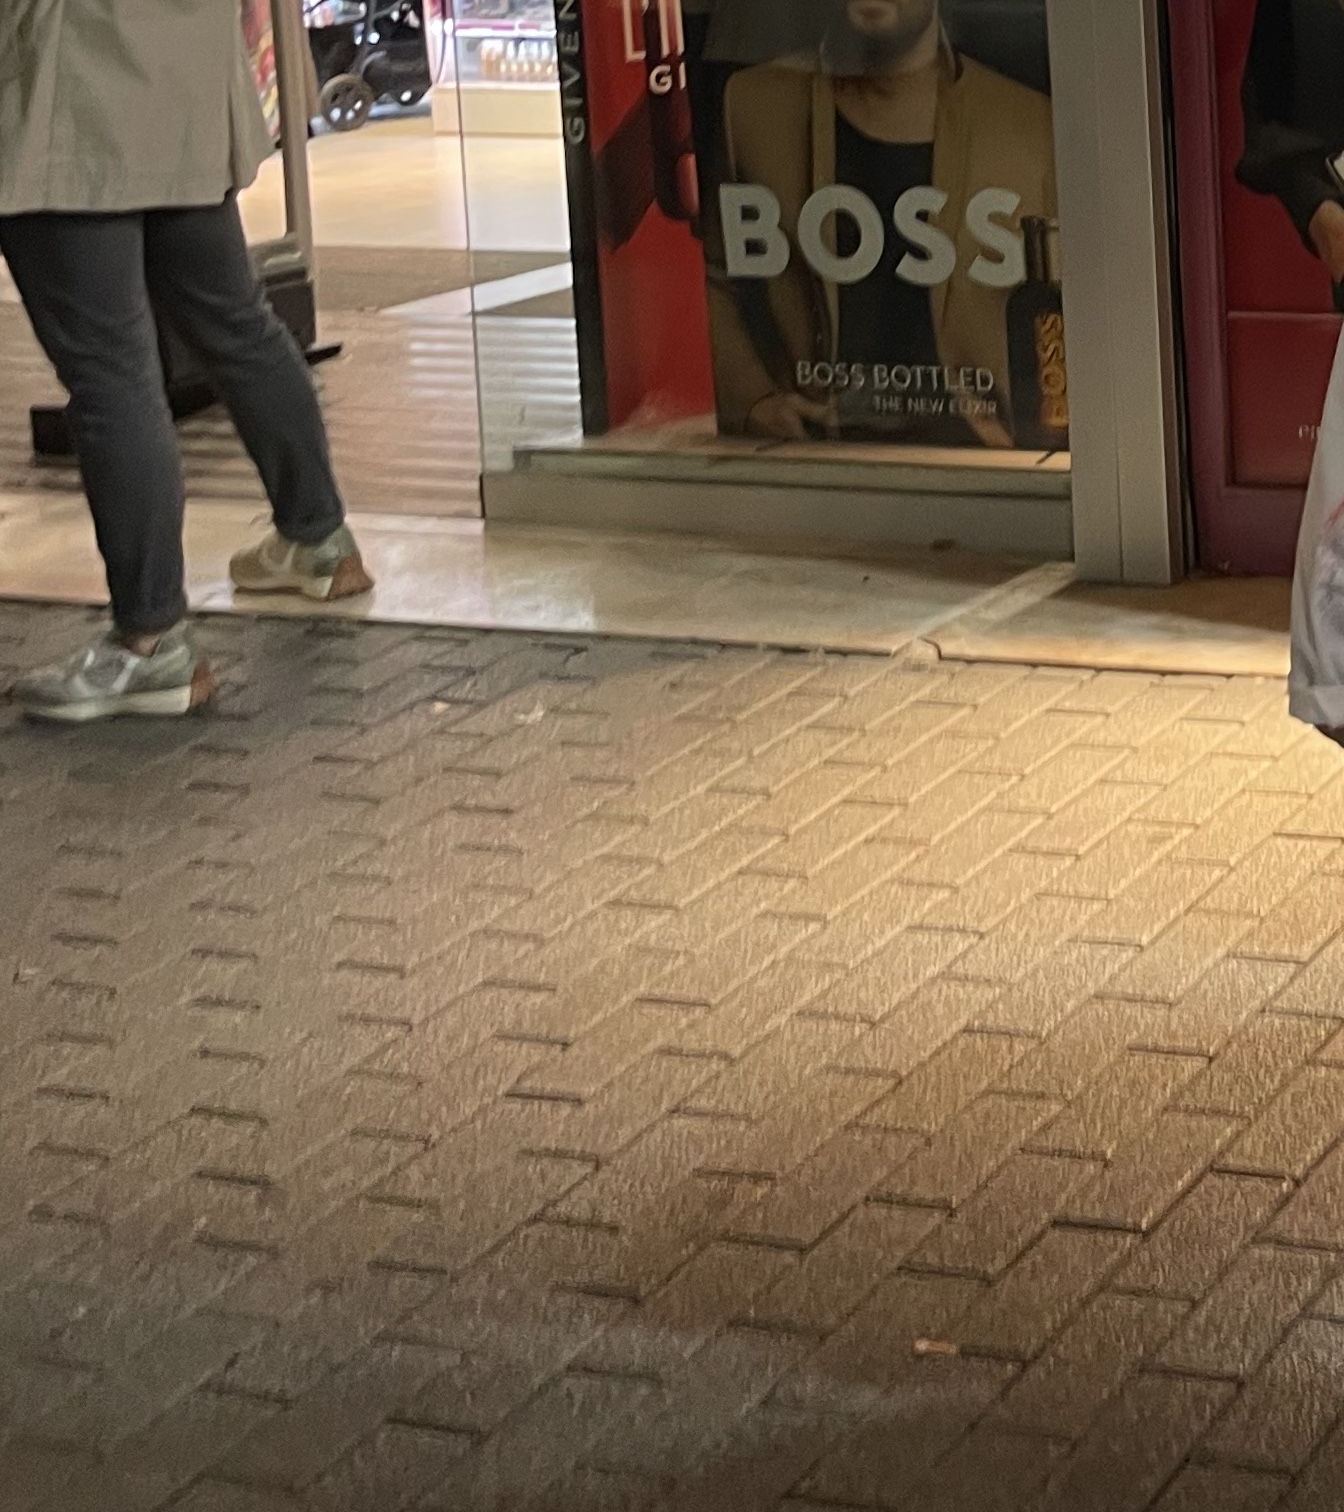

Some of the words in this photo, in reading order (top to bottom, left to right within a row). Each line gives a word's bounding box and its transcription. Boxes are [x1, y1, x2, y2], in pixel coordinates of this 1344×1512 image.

[719, 183, 1029, 288] BOSS
[796, 361, 865, 388] BOSS
[873, 363, 995, 393] BOTTLED
[873, 394, 901, 414] THE
[907, 397, 945, 416] NEW
